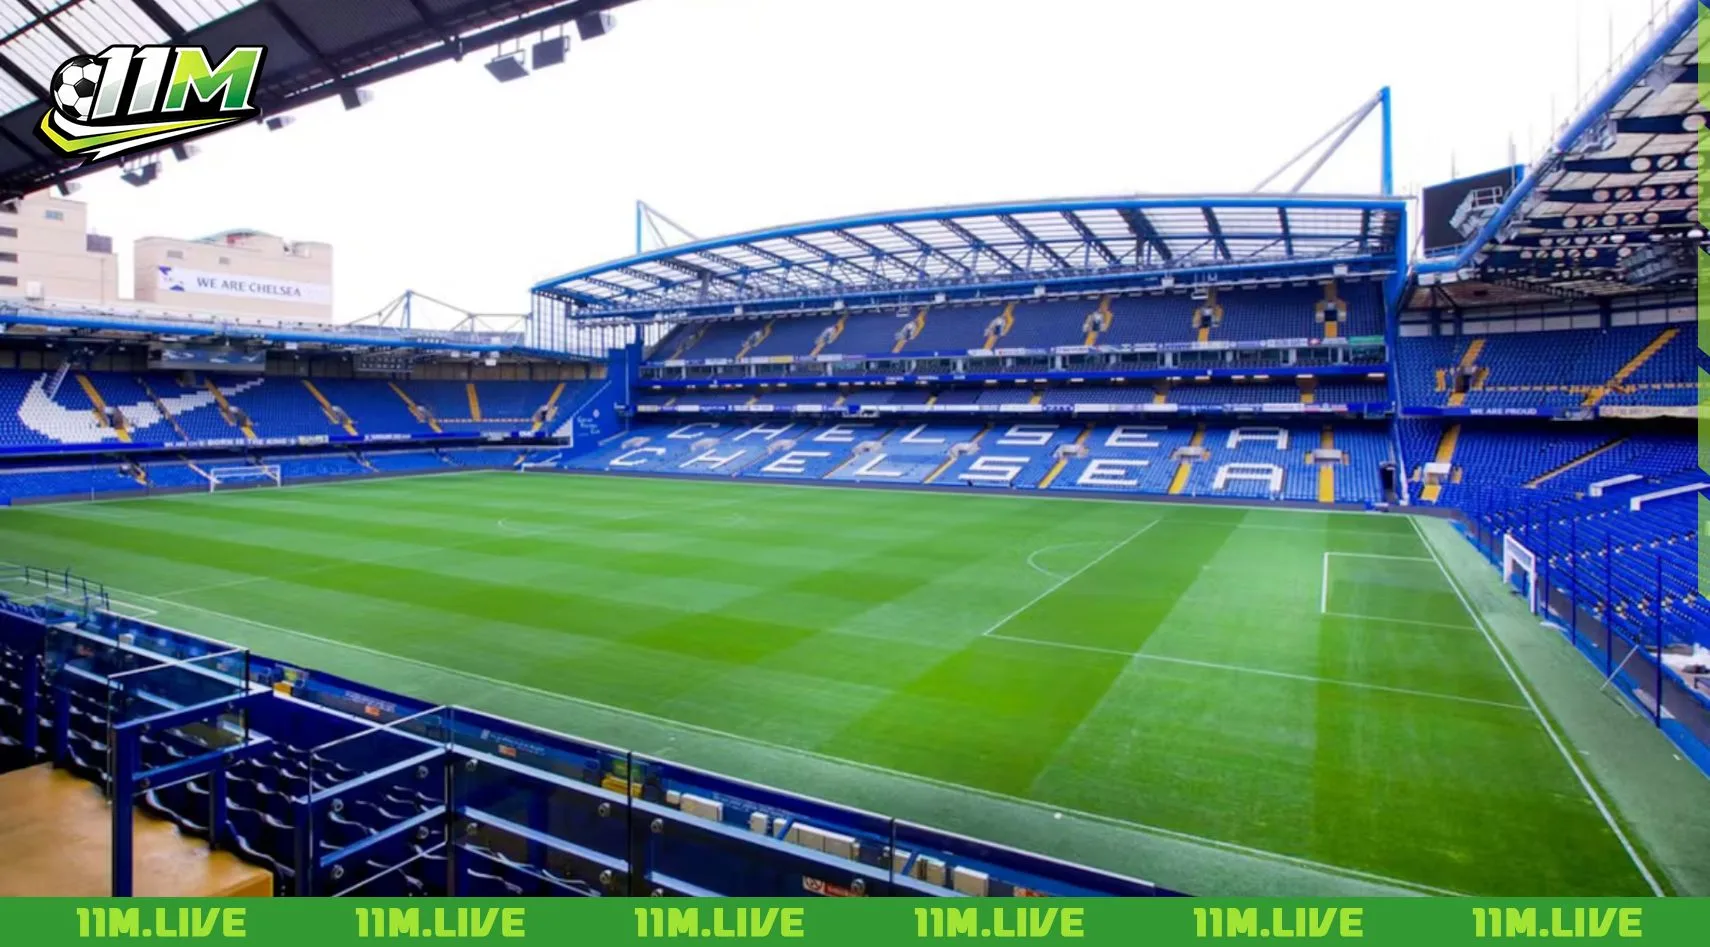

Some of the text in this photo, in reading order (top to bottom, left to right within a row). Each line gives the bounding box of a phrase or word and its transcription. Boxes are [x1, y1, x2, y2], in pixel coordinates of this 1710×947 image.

[196, 277, 302, 297] WE ARE CHELSEA
[667, 422, 1289, 450] CHELSEA
[609, 447, 1286, 493] CHELSEA
